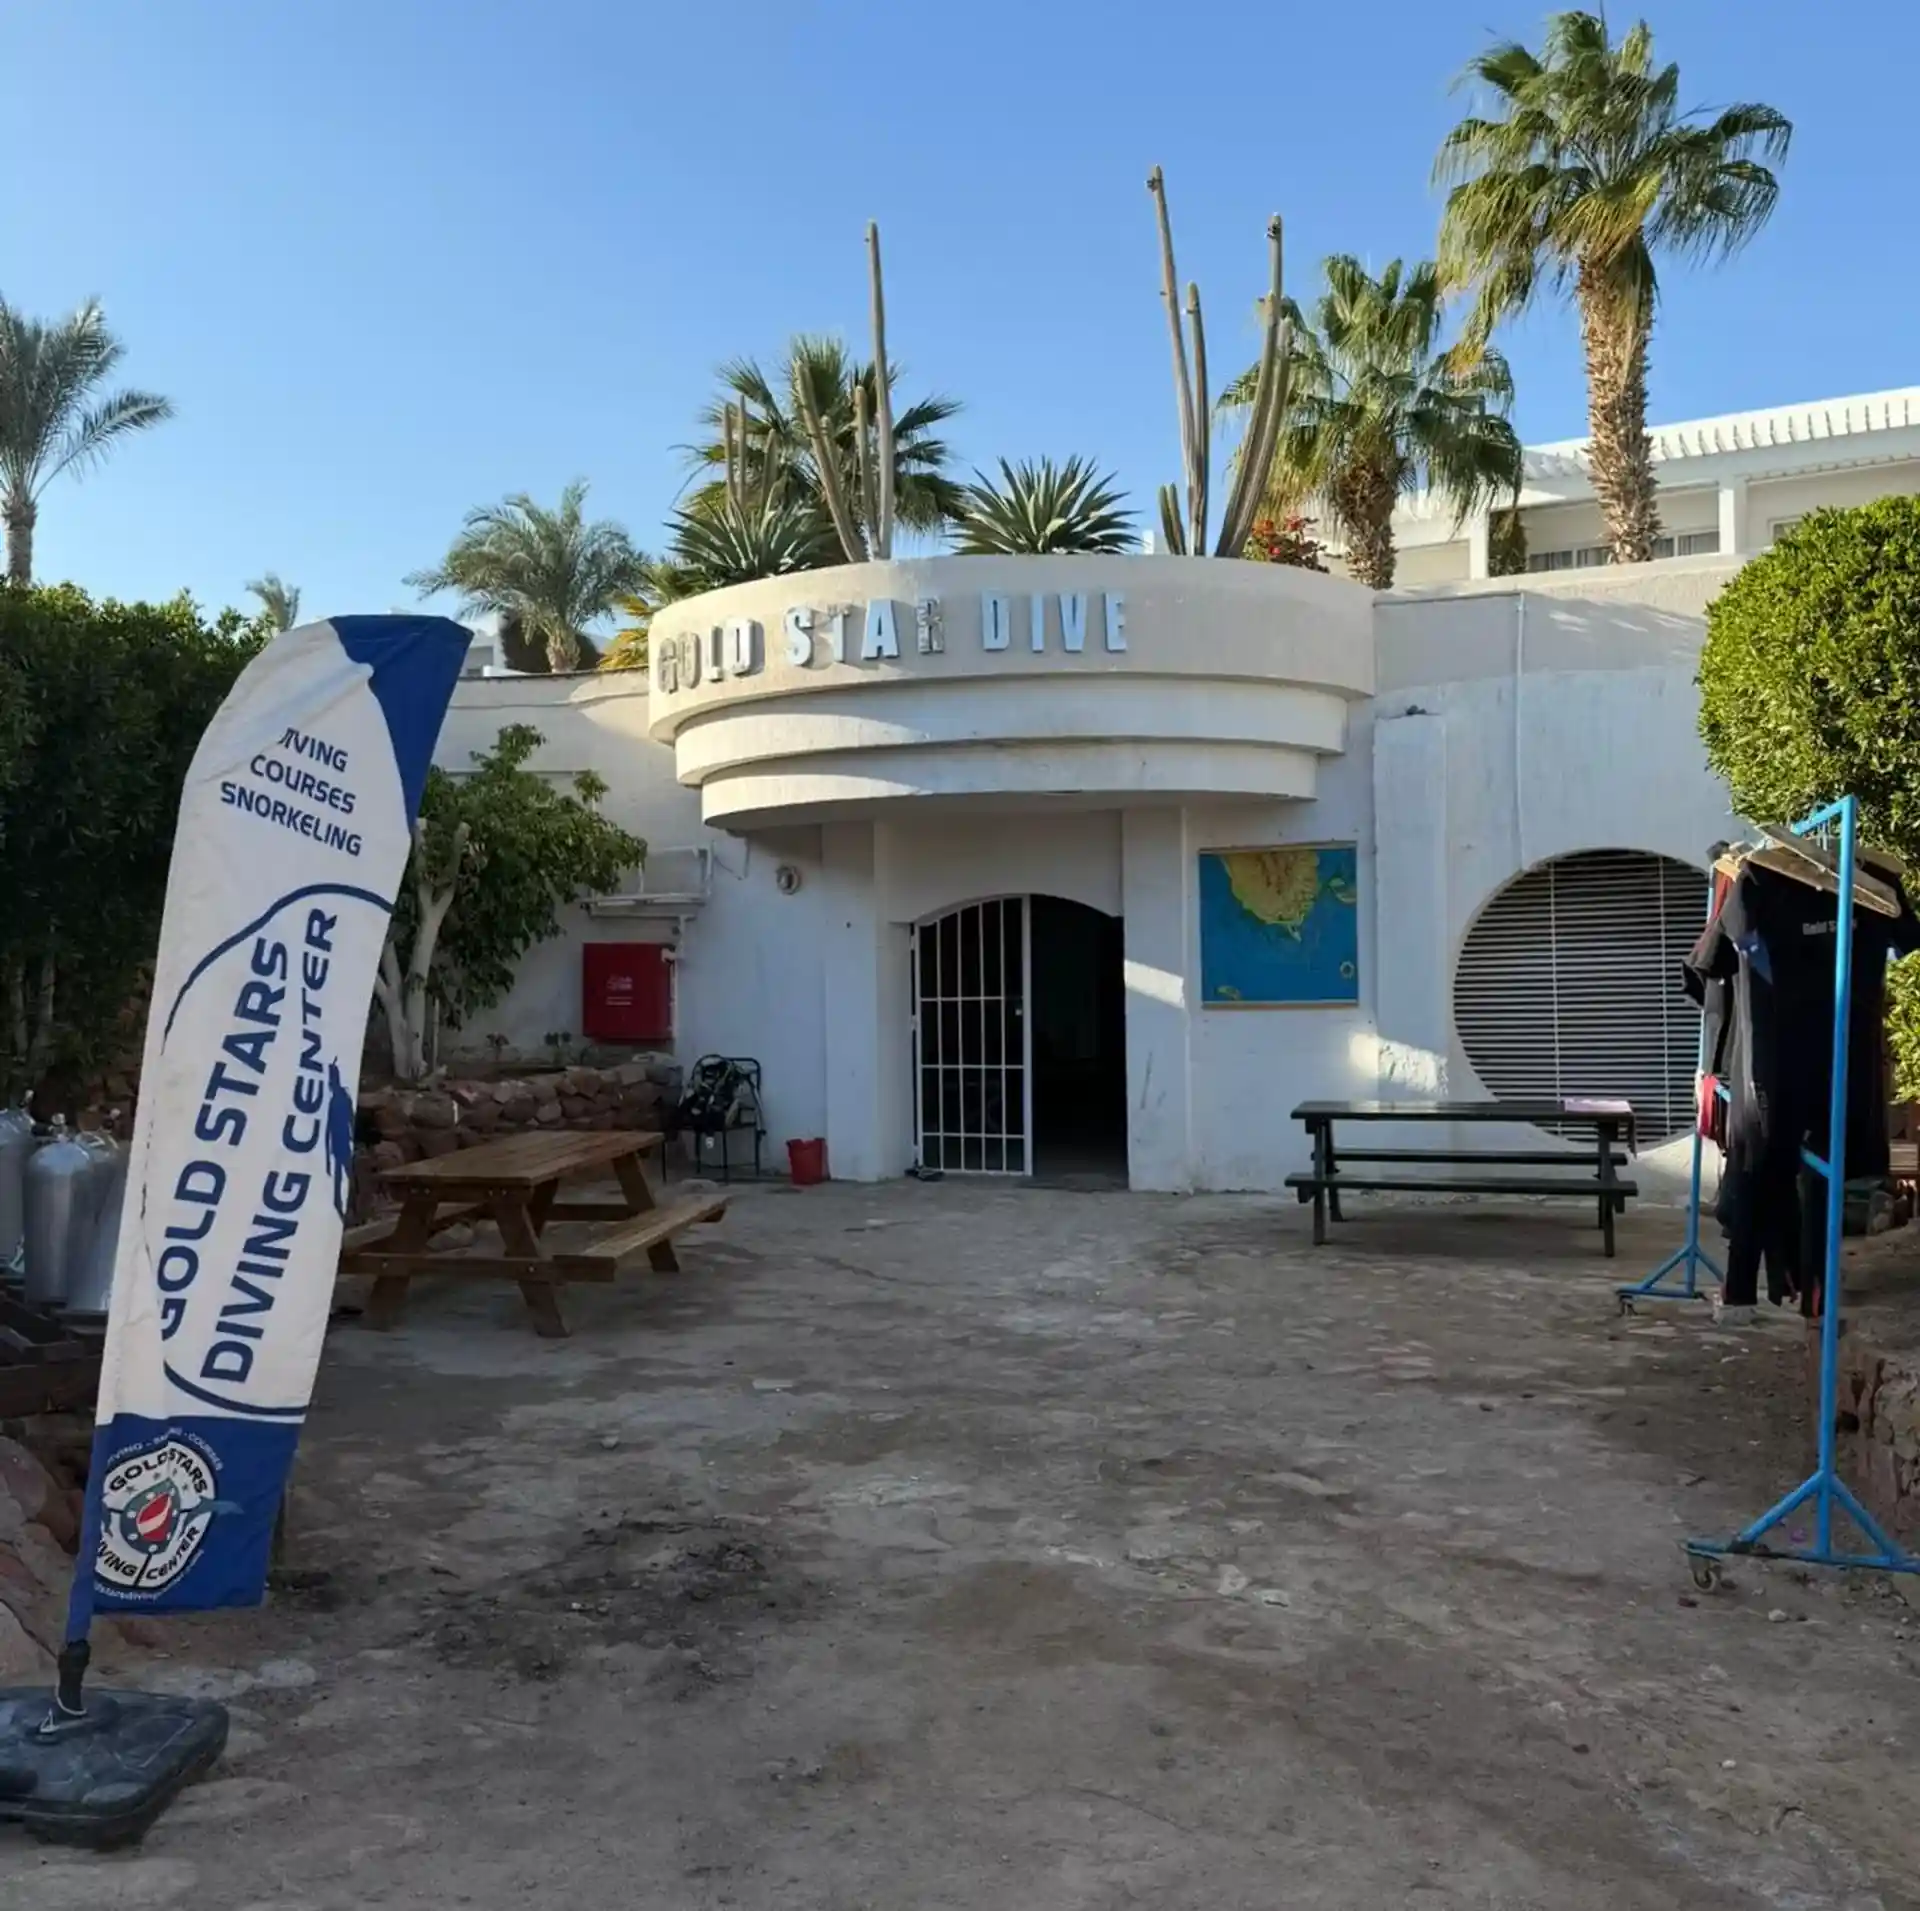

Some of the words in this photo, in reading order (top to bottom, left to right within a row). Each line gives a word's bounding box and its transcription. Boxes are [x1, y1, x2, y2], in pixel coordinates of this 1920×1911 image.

[657, 616, 756, 694] GOLD
[785, 598, 945, 667] STAR
[982, 588, 1127, 653] DIVE
[220, 781, 363, 857] SNORKELING
[250, 754, 356, 814] COURSES
[195, 937, 288, 1146] STARS
[200, 1170, 312, 1384] DIVING
[282, 908, 338, 1154] CENTER
[146, 1526, 199, 1580] CENTER
